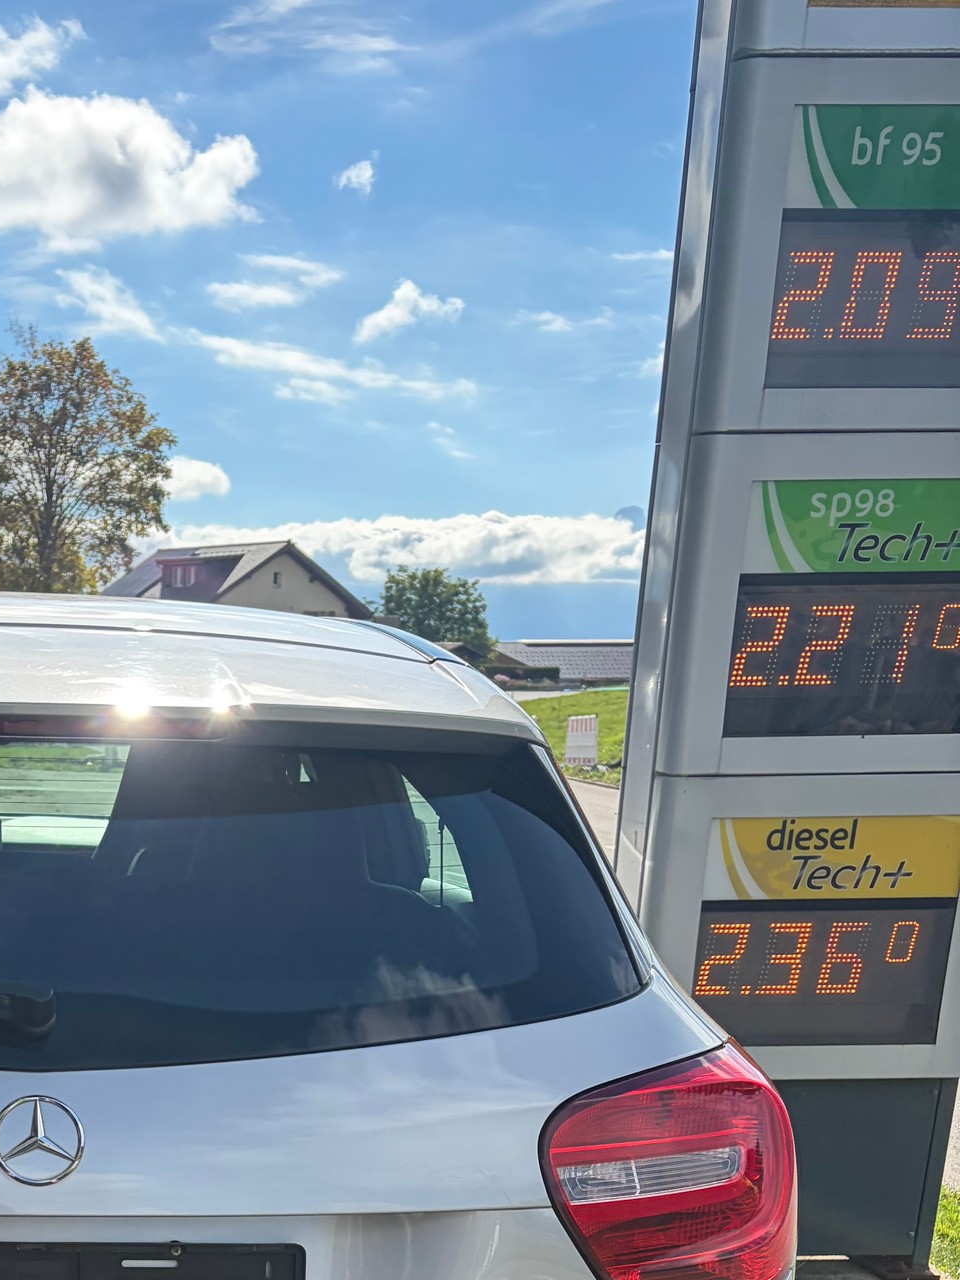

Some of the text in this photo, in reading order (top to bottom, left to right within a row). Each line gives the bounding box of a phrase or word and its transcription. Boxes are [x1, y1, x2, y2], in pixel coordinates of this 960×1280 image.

[850, 125, 945, 166] bf 95
[809, 488, 896, 527] sp98
[837, 521, 960, 564] Tech+
[766, 818, 859, 851] diesel
[792, 854, 914, 891] Tech+
